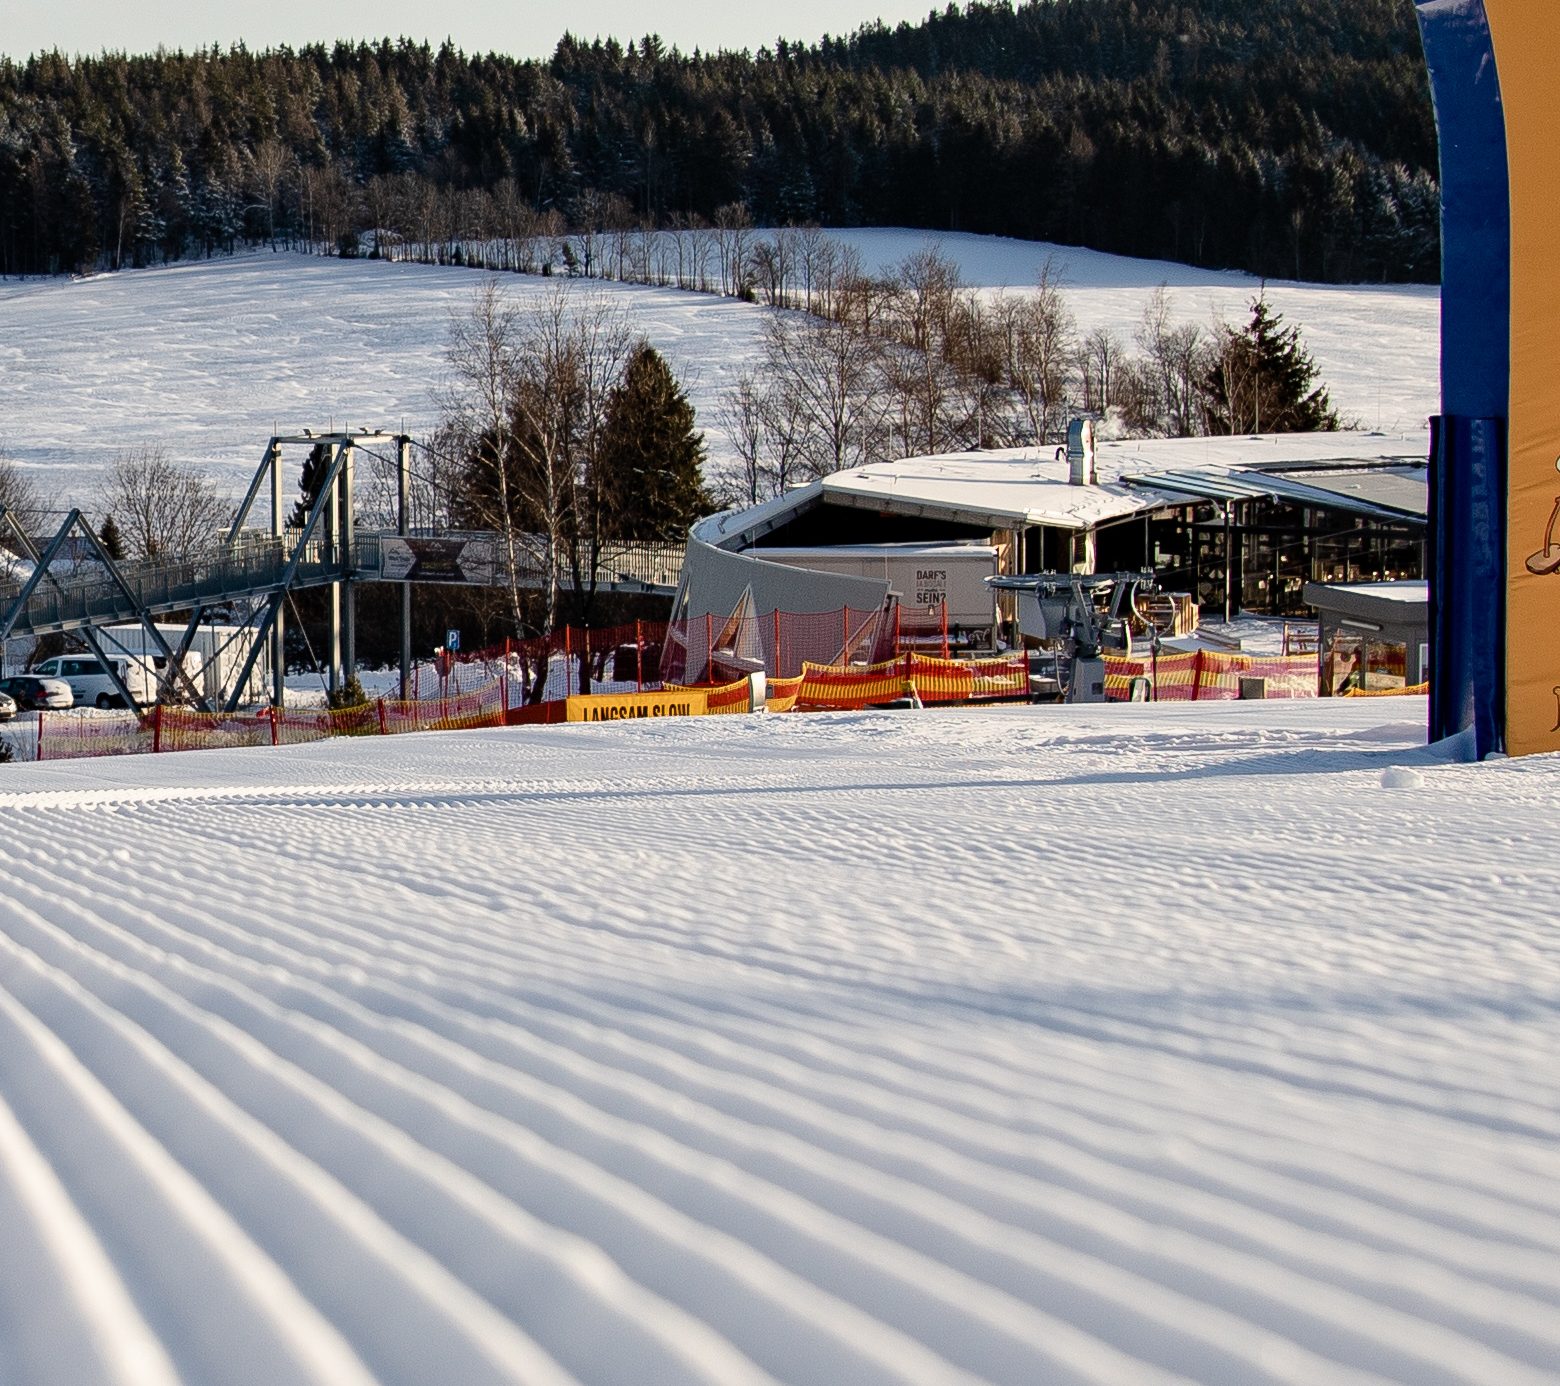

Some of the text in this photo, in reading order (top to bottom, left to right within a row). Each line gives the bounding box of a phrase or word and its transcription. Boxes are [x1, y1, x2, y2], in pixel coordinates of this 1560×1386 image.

[916, 570, 947, 580] DARF'S
[916, 592, 947, 604] SEIN?
[449, 632, 457, 647] P
